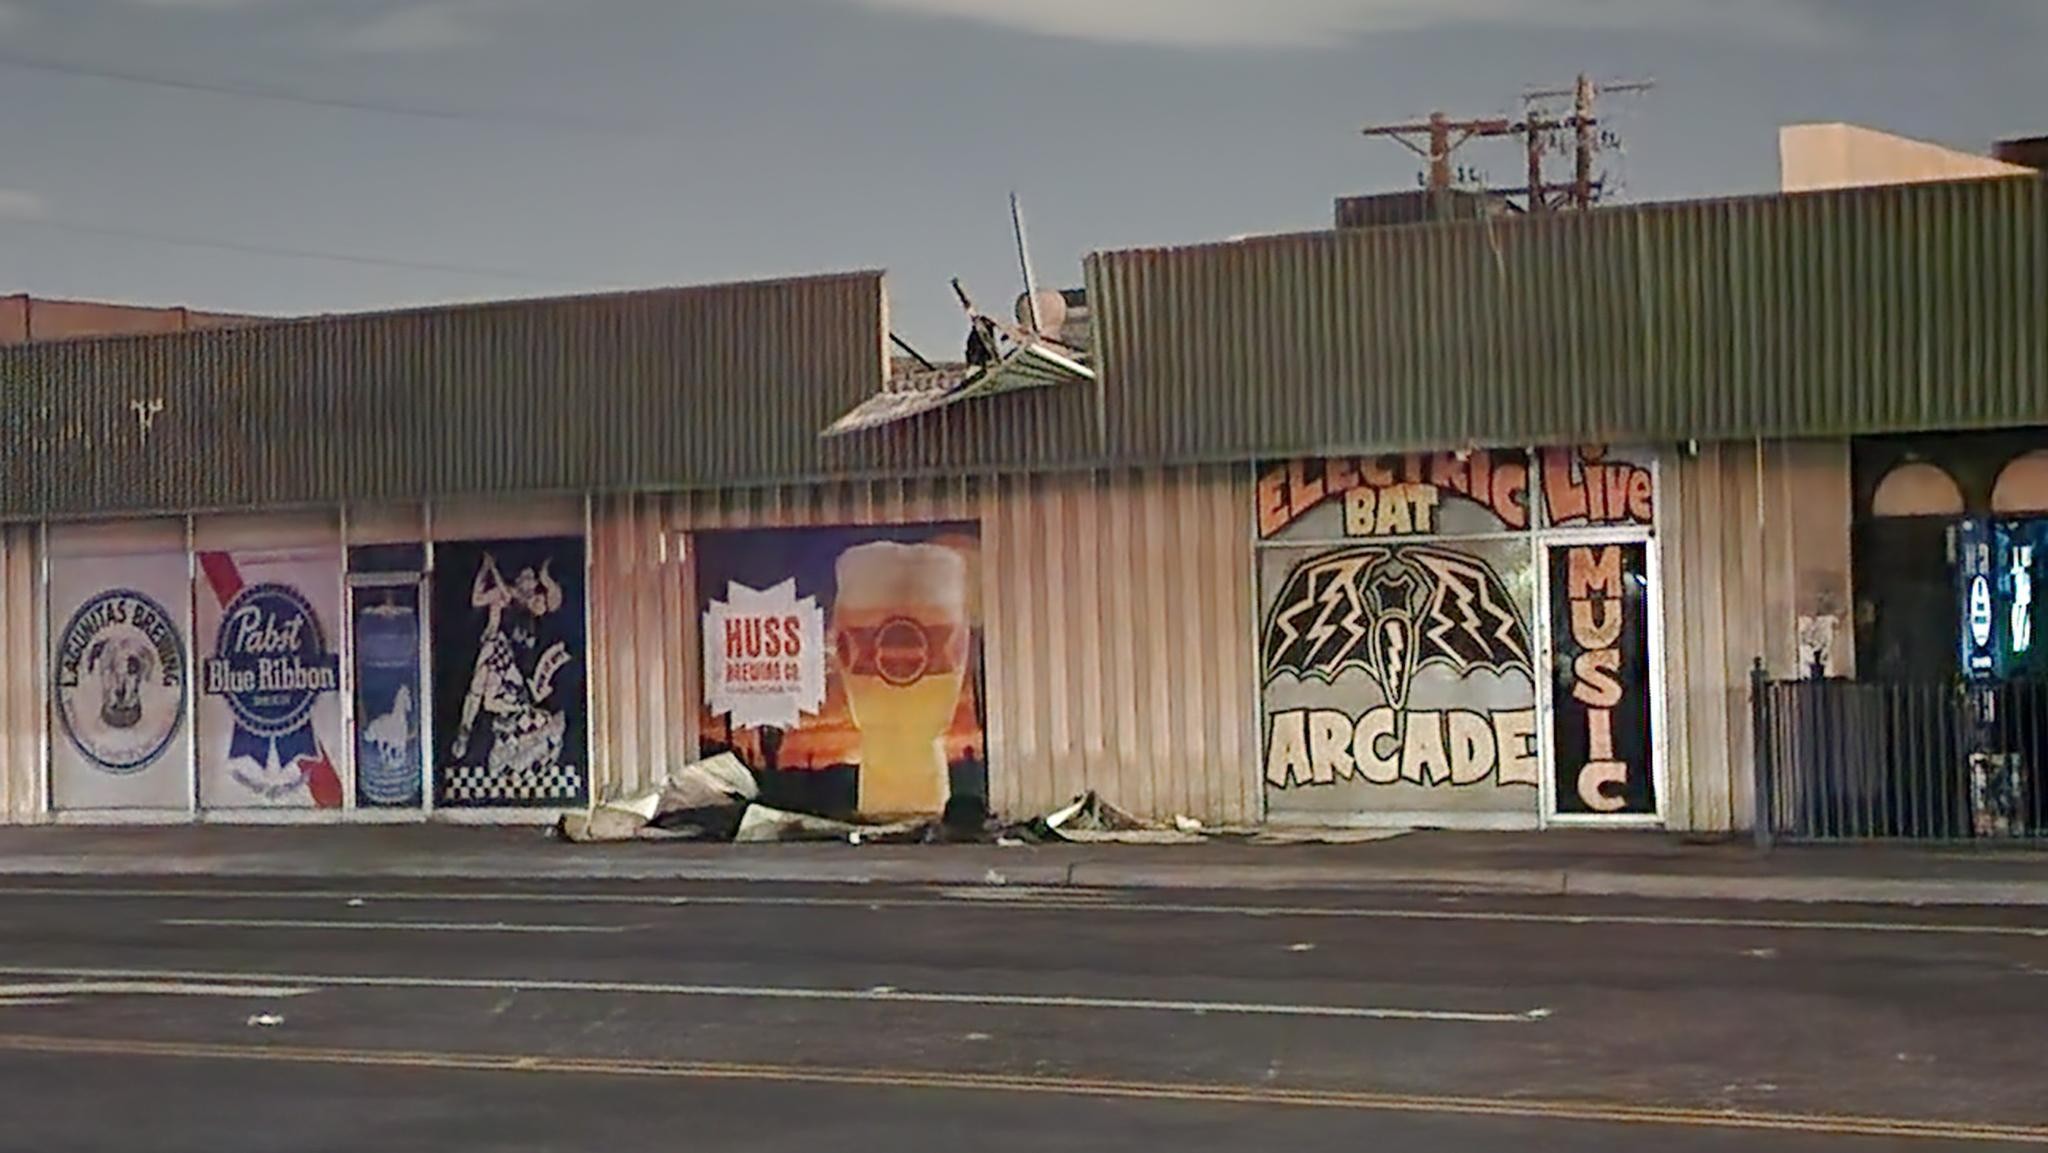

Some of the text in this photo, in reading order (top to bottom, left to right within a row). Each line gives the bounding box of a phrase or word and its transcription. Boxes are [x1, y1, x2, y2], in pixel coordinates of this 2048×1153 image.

[1343, 484, 1438, 536] BAT
[234, 605, 304, 653] Pabst
[725, 615, 801, 658] HUSS
[208, 657, 337, 692] Blue Ribbon
[1566, 543, 1628, 813] MUSIC
[1265, 705, 1539, 789] ARCADE
